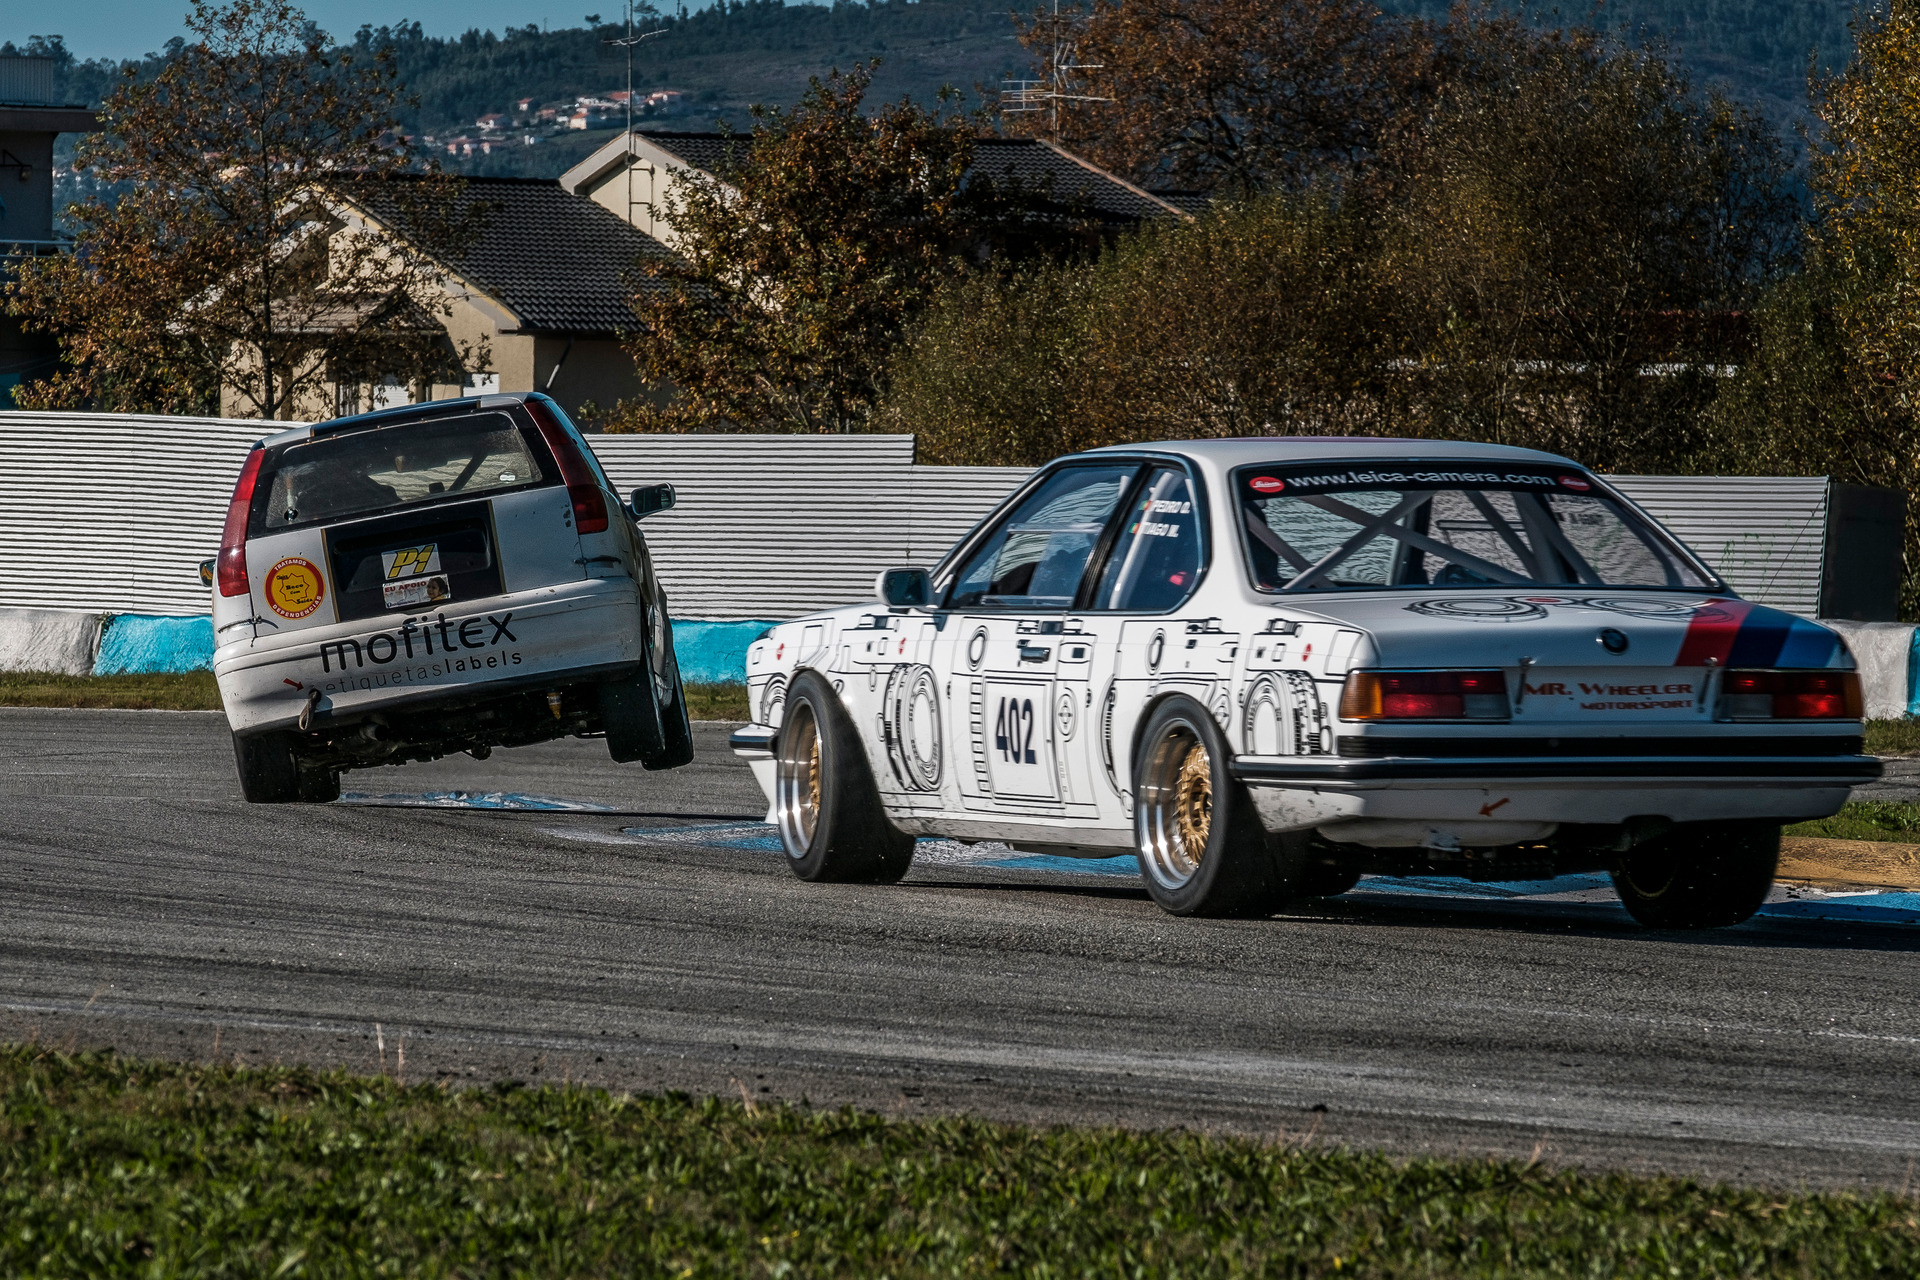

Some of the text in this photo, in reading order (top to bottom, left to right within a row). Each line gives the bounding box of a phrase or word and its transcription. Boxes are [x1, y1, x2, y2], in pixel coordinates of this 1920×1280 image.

[1286, 470, 1556, 488] www.leica-camera.com
[274, 559, 307, 571] TRATAMOS
[388, 544, 435, 578] P1
[398, 580, 427, 592] APOIO
[320, 612, 517, 674] mofitex
[1524, 682, 1573, 696] MR.
[1579, 699, 1693, 711] MOTORSPORT
[995, 696, 1038, 765] 402
